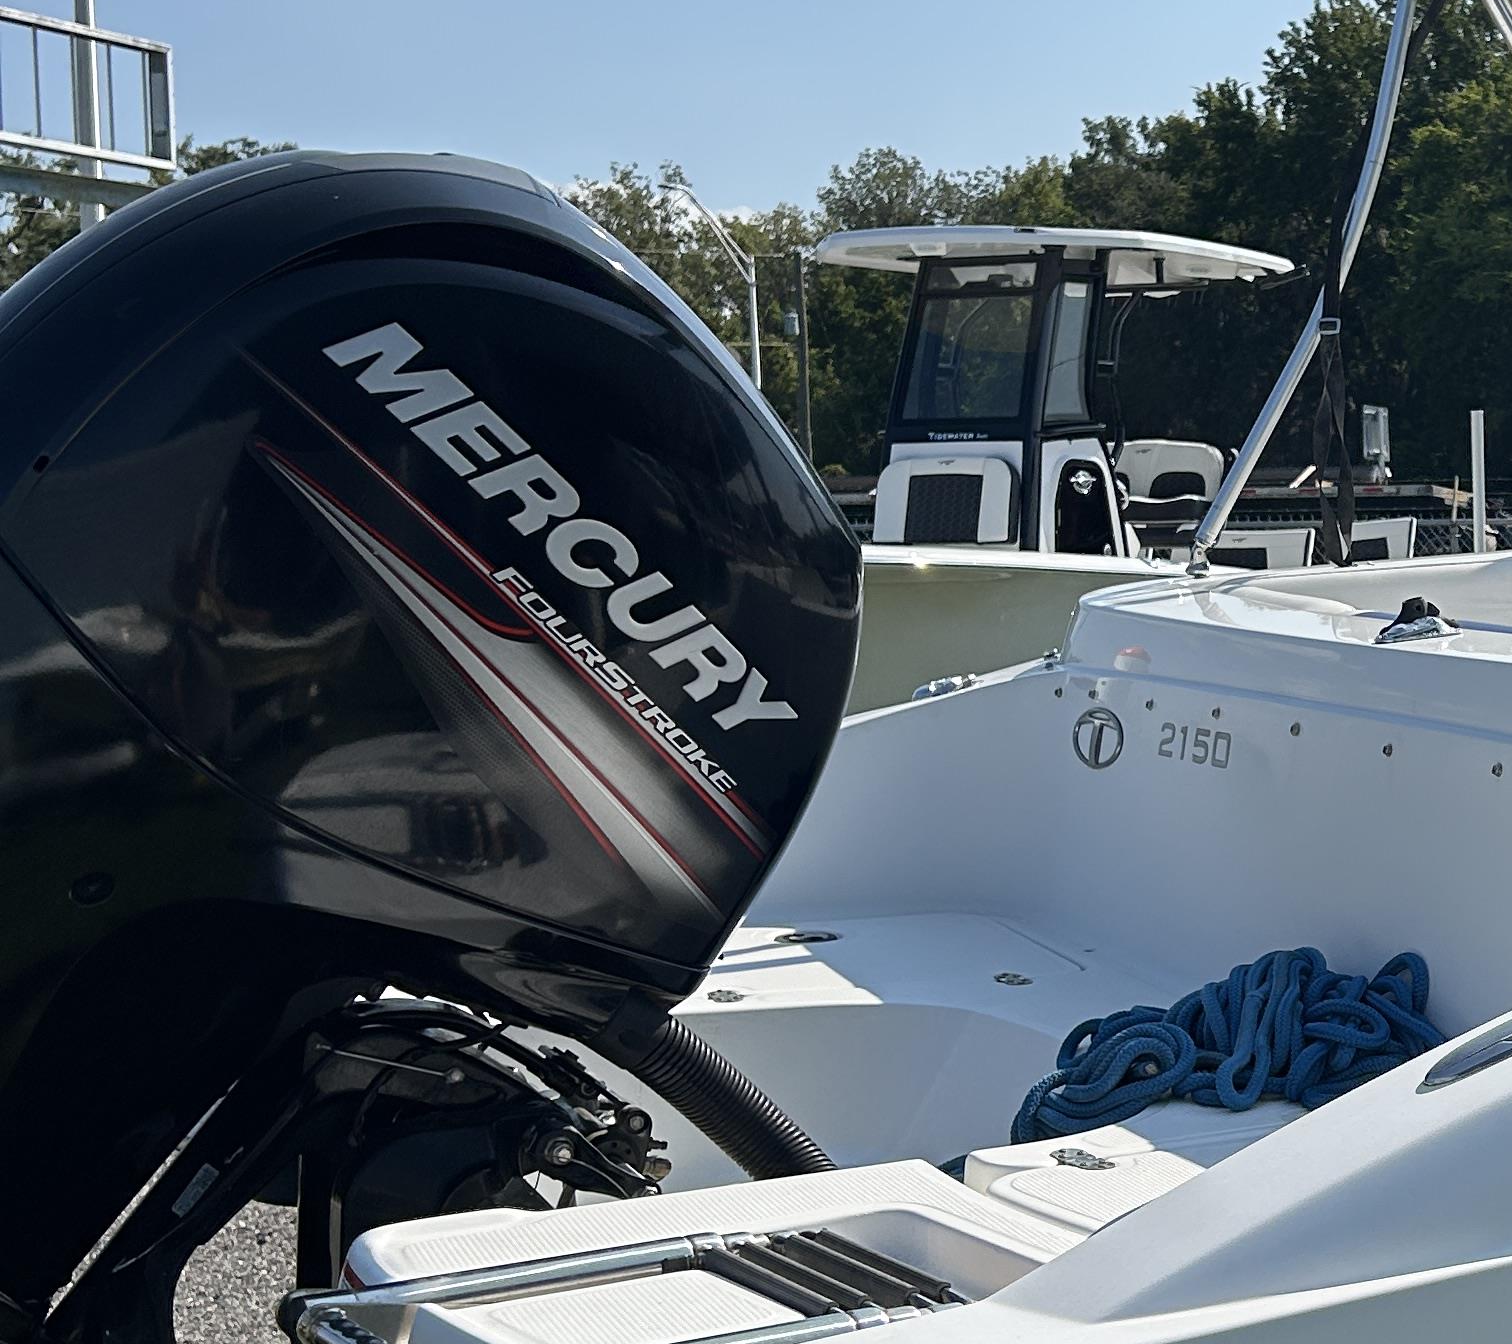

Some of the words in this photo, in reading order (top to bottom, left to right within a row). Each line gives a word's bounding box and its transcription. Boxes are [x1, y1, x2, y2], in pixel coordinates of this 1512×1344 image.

[321, 321, 799, 732] MERCURY
[492, 566, 738, 793] FOURSTROKE
[1157, 721, 1232, 769] 2150
